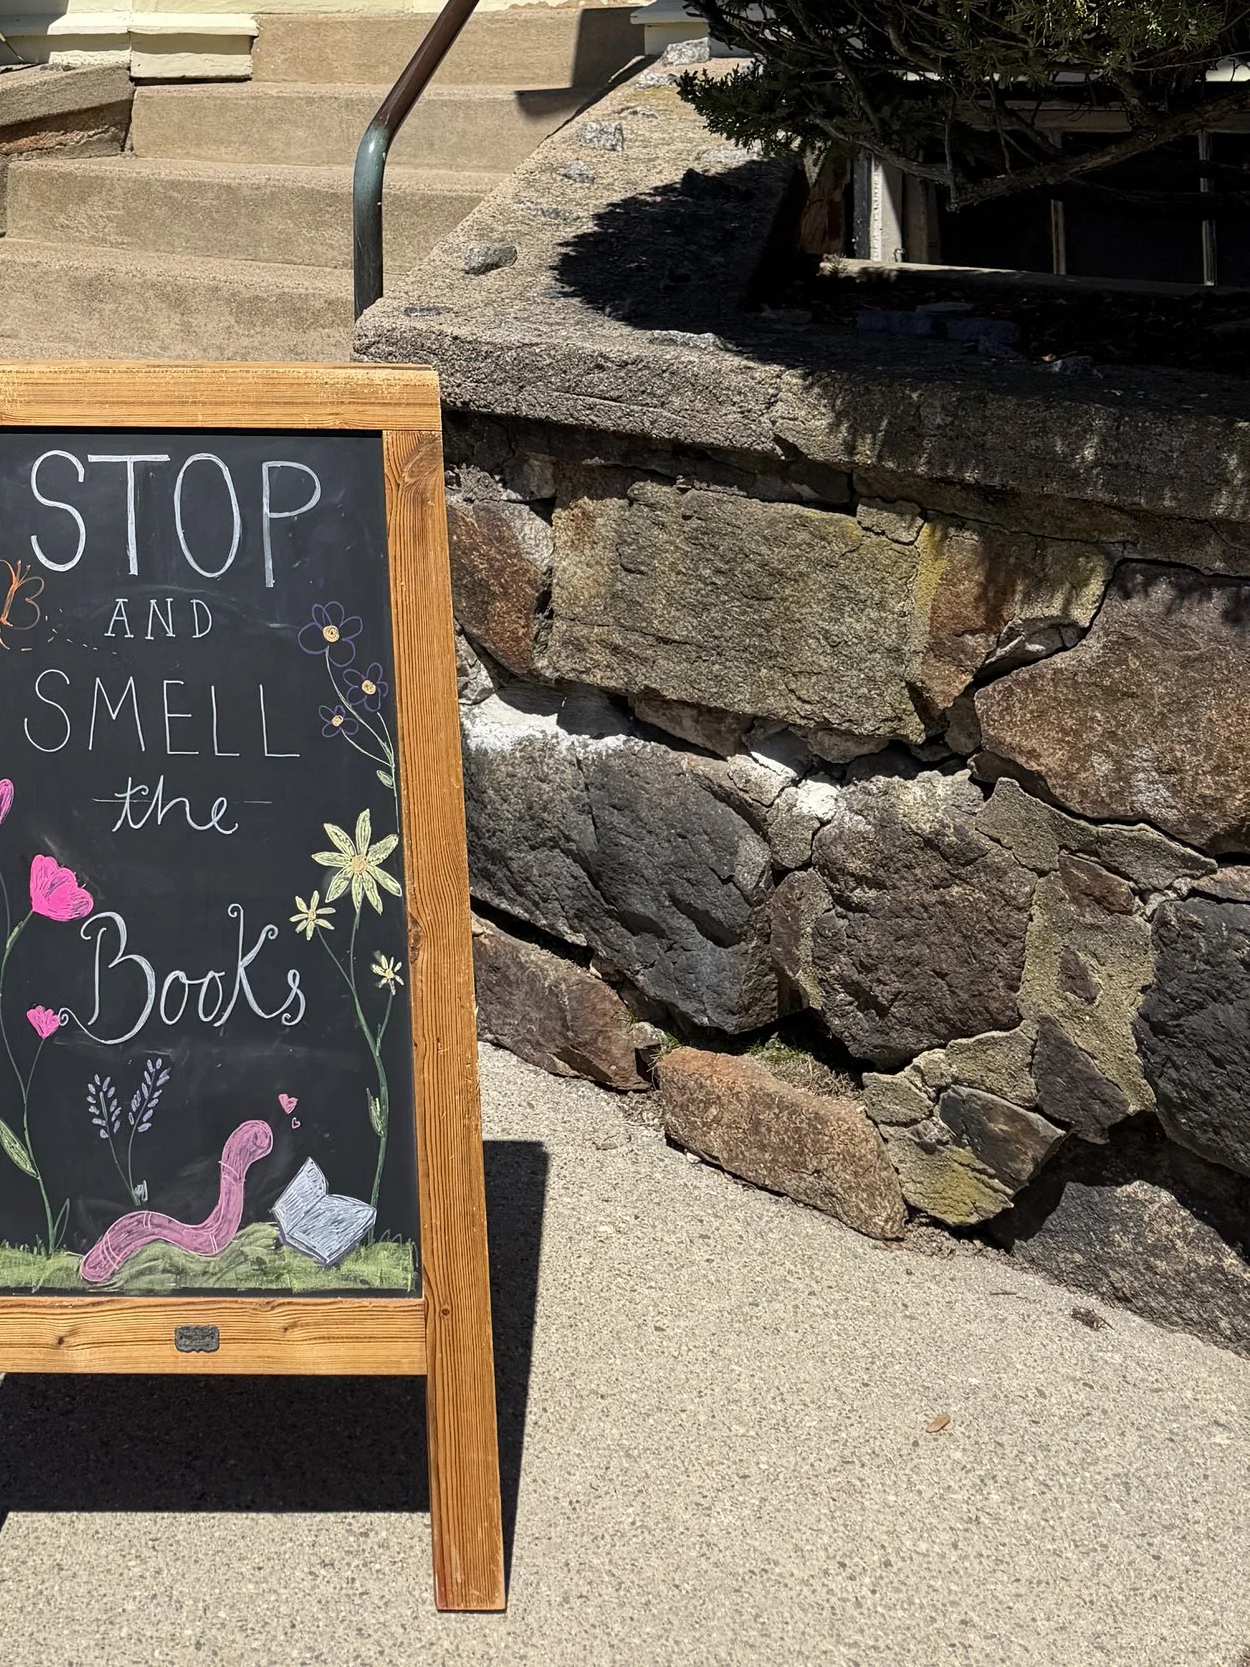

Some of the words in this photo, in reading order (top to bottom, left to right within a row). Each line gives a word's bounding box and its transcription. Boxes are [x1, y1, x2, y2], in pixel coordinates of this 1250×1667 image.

[30, 449, 321, 588] STOP
[104, 598, 213, 640] AND
[24, 669, 300, 757] SMELL
[112, 775, 239, 835] the
[58, 903, 306, 1045] Books
